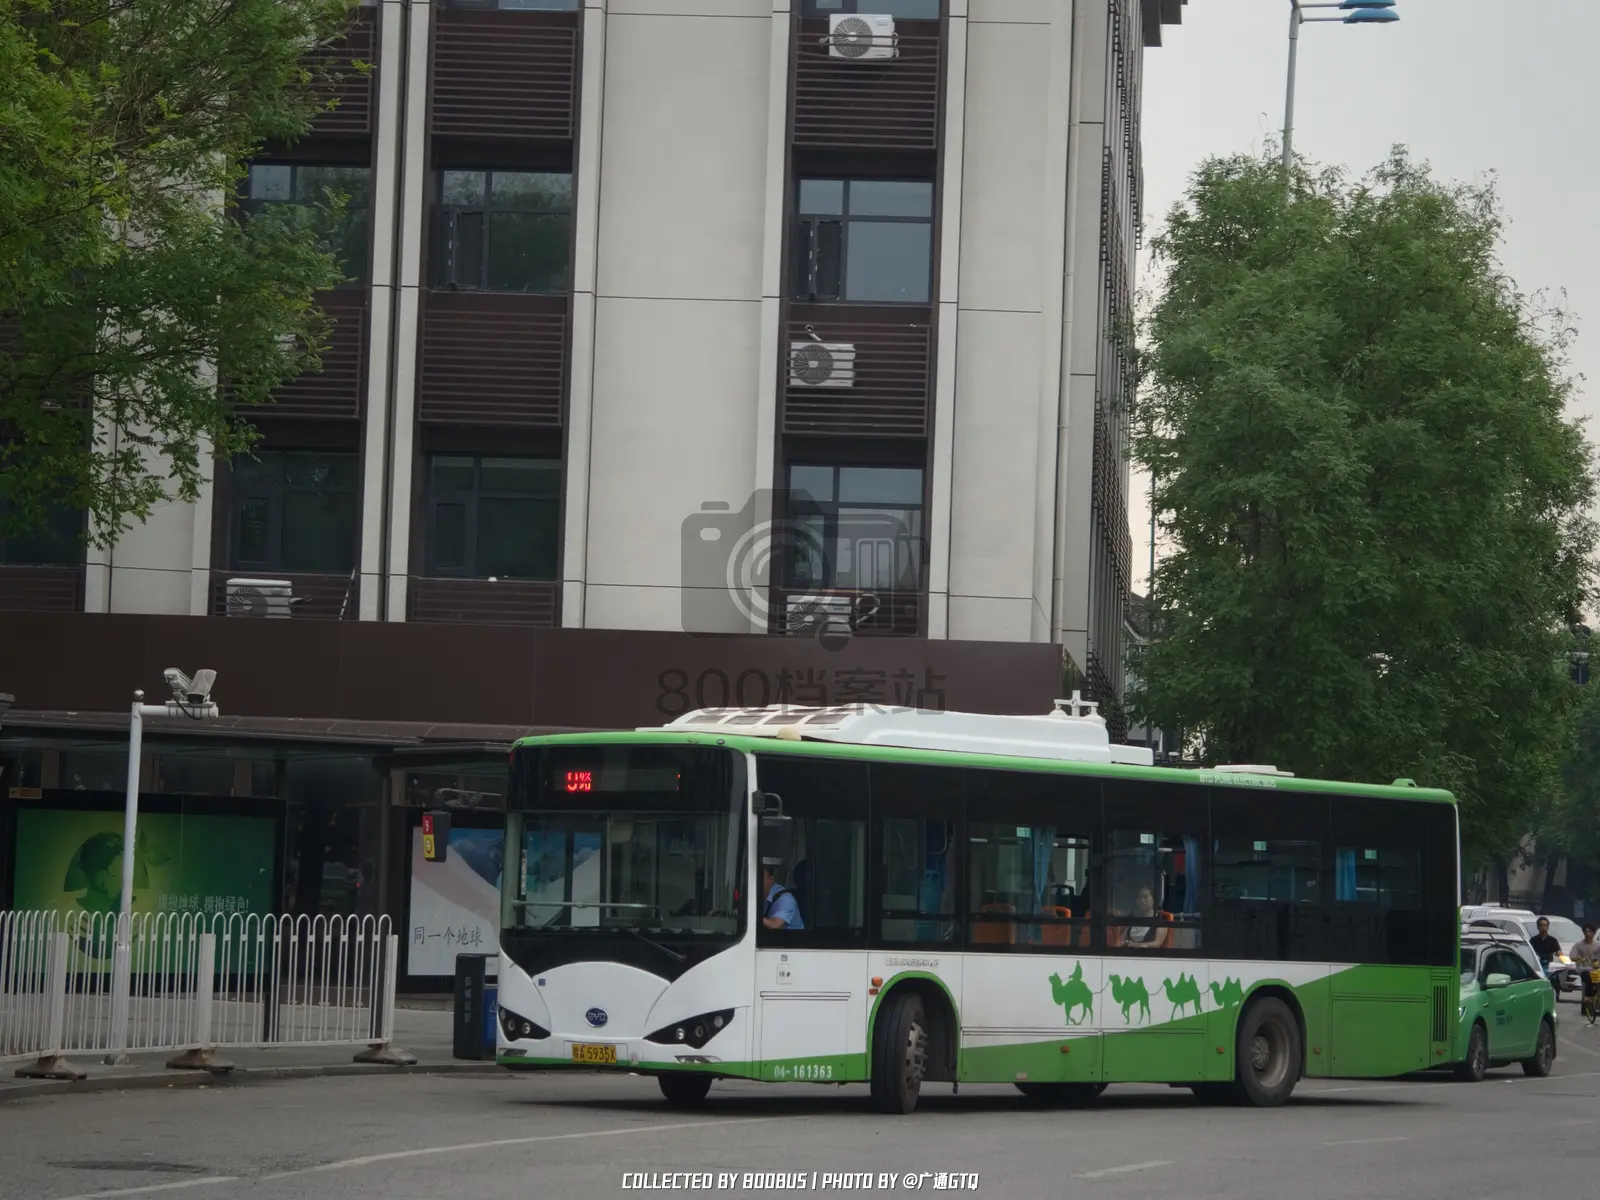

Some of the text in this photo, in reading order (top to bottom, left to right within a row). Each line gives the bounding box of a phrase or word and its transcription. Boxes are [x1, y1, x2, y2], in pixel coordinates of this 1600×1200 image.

[414, 926, 483, 946] 同一个地球
[774, 1065, 832, 1078] 04-161363
